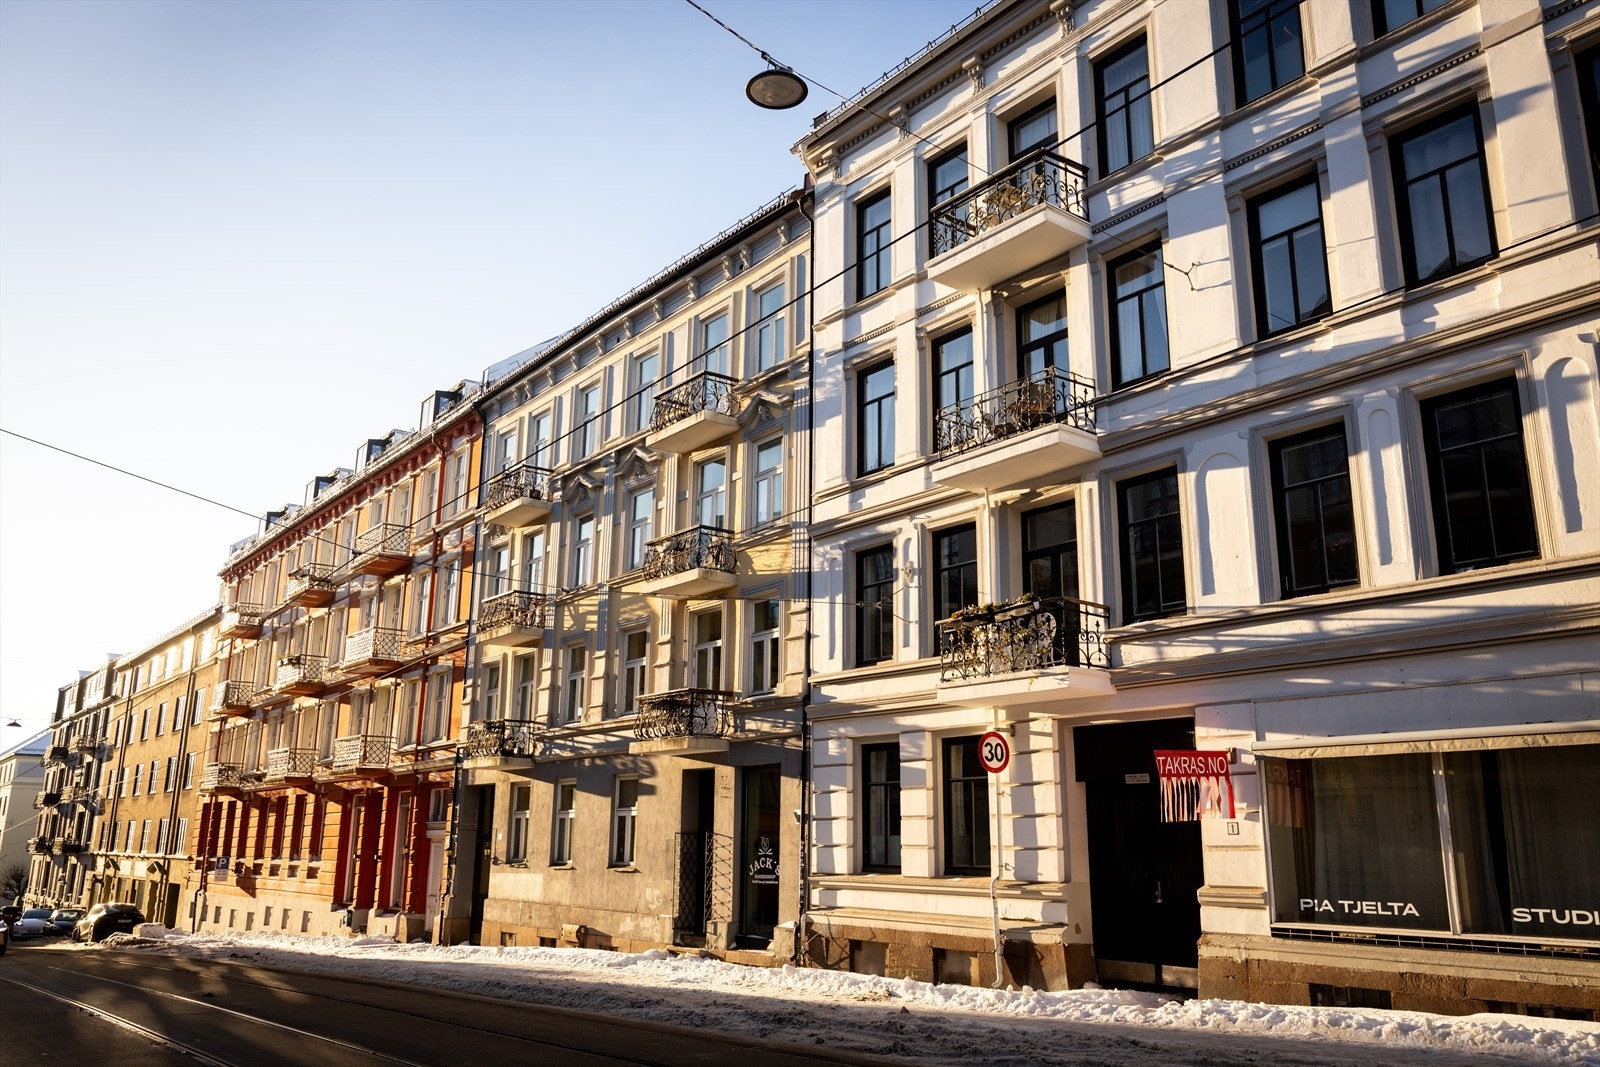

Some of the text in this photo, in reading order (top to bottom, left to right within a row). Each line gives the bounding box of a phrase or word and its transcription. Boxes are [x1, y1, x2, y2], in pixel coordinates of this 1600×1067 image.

[984, 742, 1004, 762] 30
[1156, 756, 1227, 774] TAKRAS.NO
[218, 858, 227, 868] P
[1299, 898, 1600, 926] PIA TJELTA STUDI
